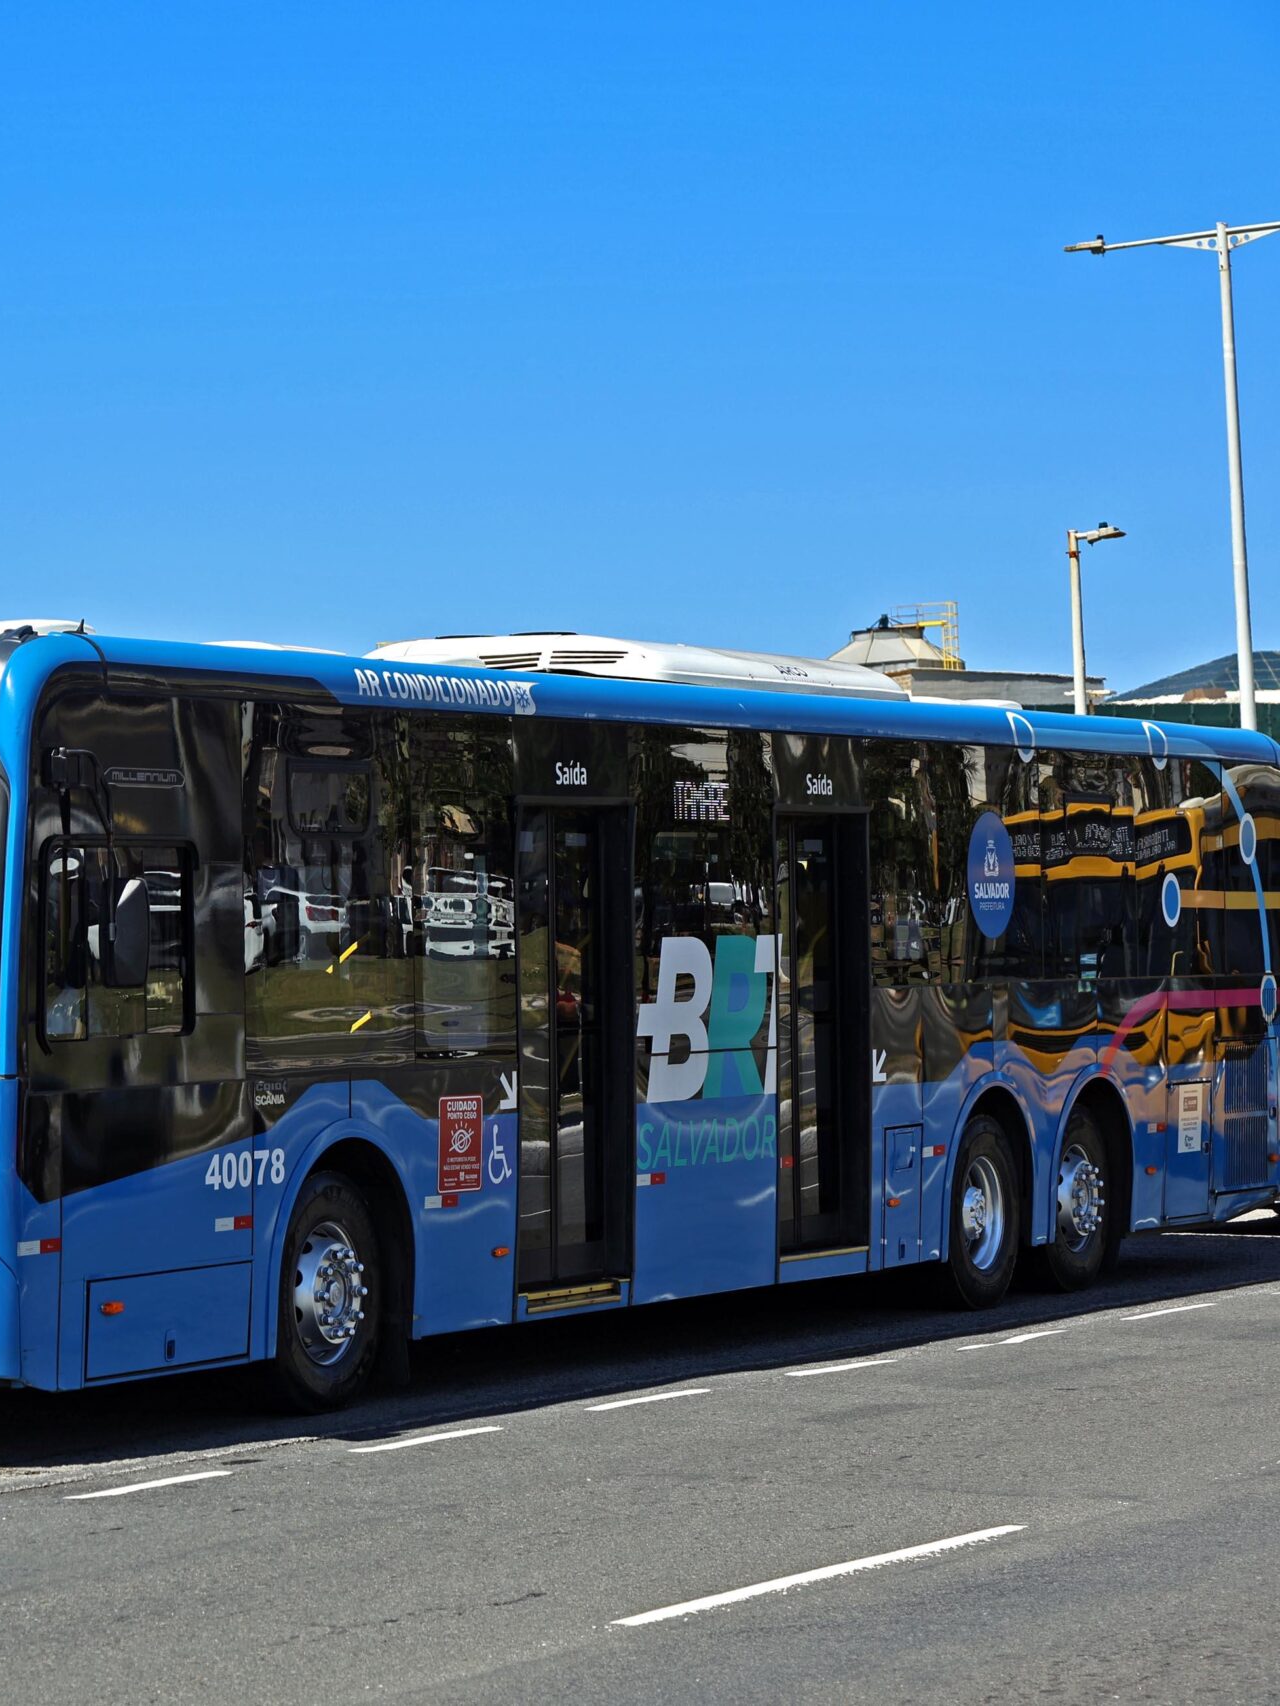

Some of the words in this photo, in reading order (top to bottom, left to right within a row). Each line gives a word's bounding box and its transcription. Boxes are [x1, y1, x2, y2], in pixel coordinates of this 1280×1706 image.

[354, 668, 382, 697] AR
[383, 671, 513, 707] CONDICIONADO
[555, 761, 588, 786] Saída
[806, 773, 833, 796] Saída
[974, 882, 1010, 899] SALVADOR
[979, 902, 1005, 911] PREFEITURA
[255, 1094, 285, 1106] SCANIA
[447, 1101, 477, 1111] CUIDADO
[447, 1112, 463, 1120] PONTO
[637, 1115, 777, 1171] SALVADOR
[205, 1148, 285, 1190] 40078
